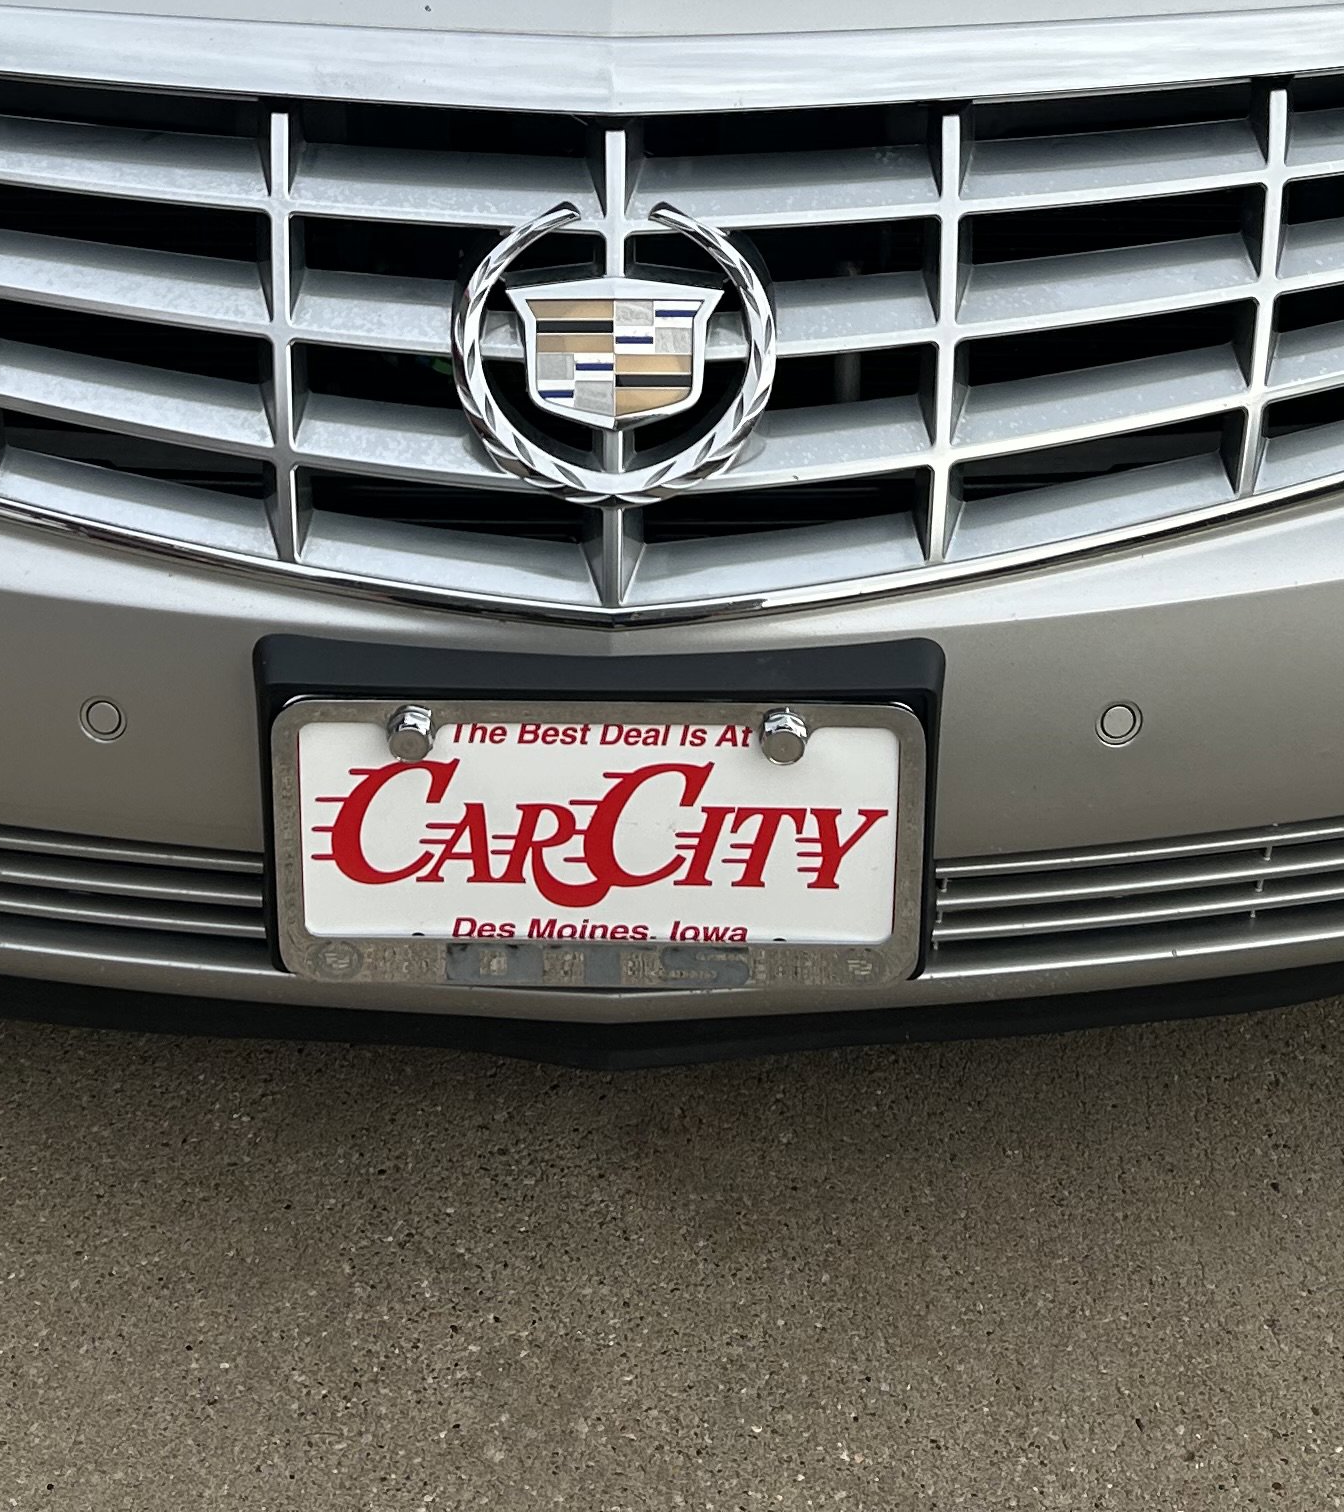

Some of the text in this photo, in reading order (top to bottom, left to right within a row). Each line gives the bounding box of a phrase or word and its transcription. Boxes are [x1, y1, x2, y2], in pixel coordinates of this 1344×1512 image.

[452, 723, 753, 748] The Best Deal Is At
[451, 918, 516, 939] Des
[669, 920, 749, 943] Iowa
